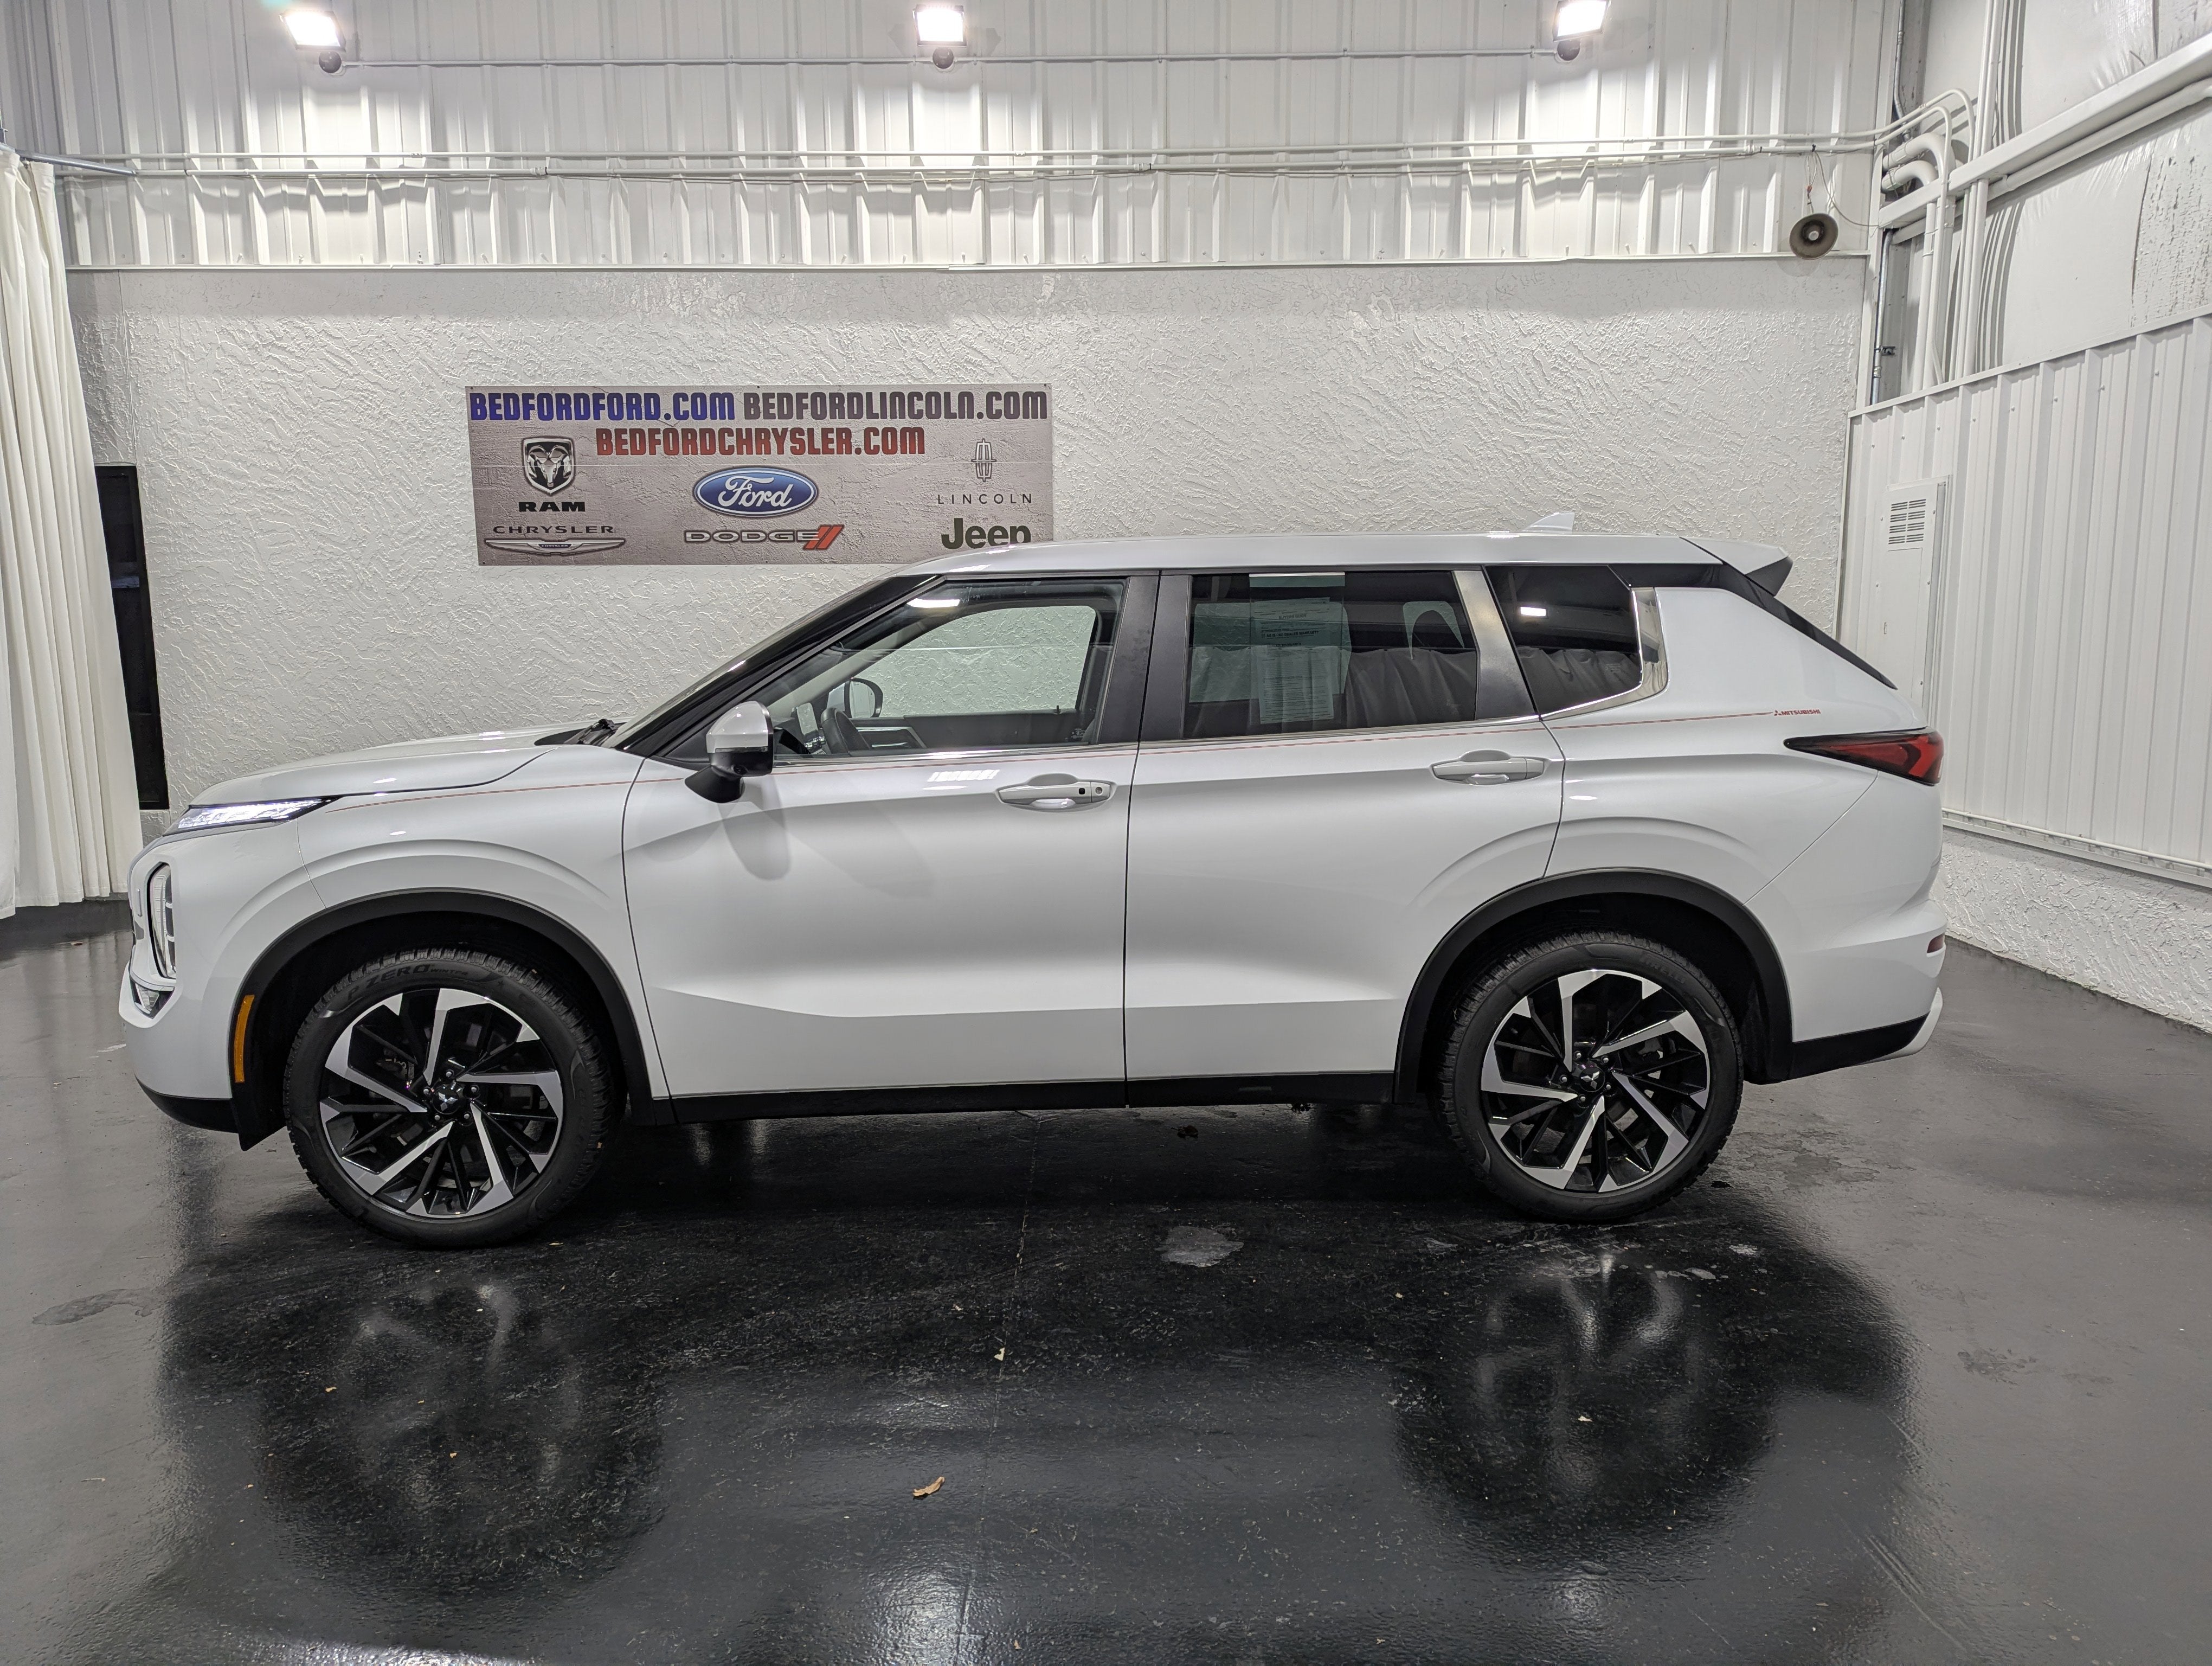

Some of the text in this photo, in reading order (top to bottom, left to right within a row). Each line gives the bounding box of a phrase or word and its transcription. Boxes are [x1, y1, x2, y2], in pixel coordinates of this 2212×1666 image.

[470, 391, 1047, 421] BEDFORDFORD.COM BEDFORDLINCOLN.COM
[596, 427, 925, 456] BEDFORDCHRYSLER.COM
[718, 475, 794, 507] Ford
[937, 494, 1032, 504] LINCOLN
[518, 501, 586, 512] RAM
[493, 525, 614, 534] CHRYSLER
[685, 531, 820, 542] DODGE
[941, 517, 1031, 549] Jeep
[366, 964, 432, 989] ZERO
